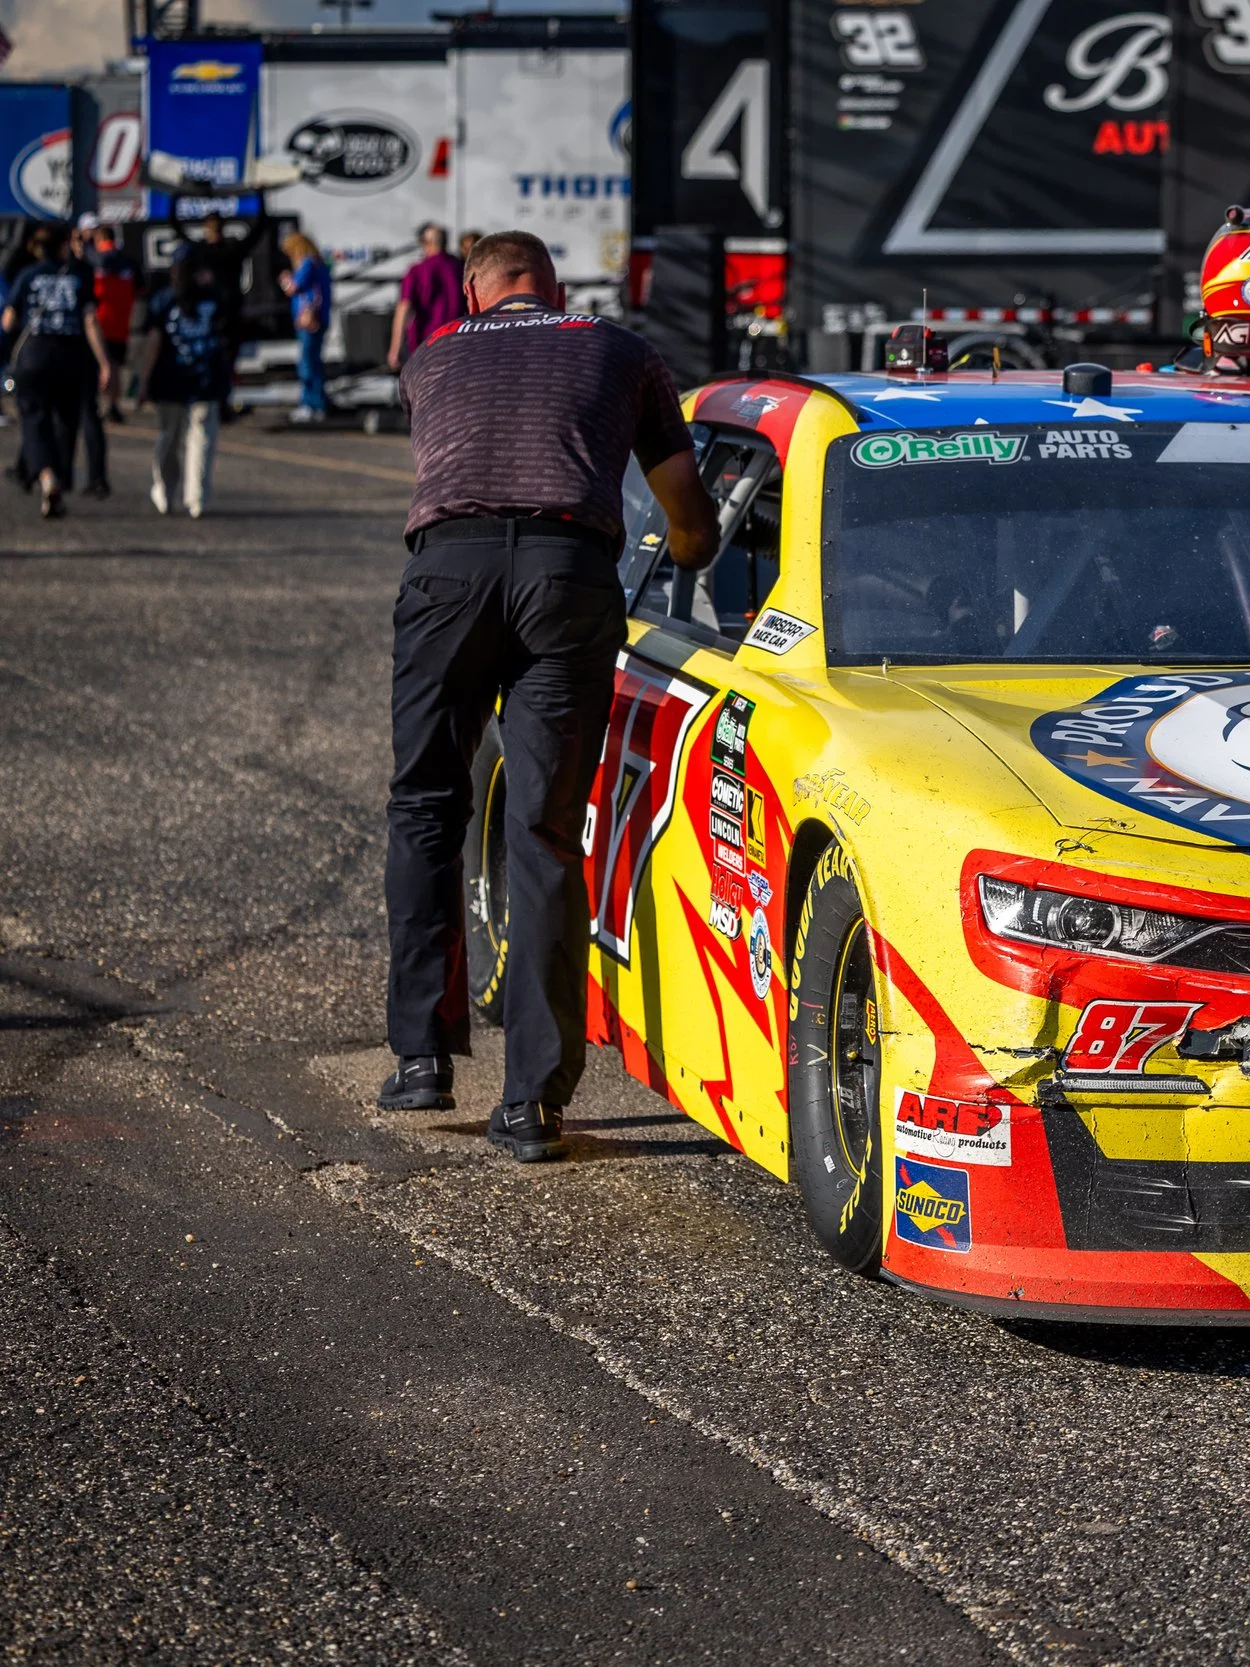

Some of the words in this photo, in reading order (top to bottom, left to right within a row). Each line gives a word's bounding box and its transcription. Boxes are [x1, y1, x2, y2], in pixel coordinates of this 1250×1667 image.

[836, 12, 923, 66] 32
[859, 433, 1020, 465] O'Reilly
[1038, 443, 1133, 460] PARTS
[1046, 430, 1120, 444] AUTO
[752, 629, 772, 642] RACE
[768, 634, 788, 649] CAR
[768, 616, 803, 637] NASCAR
[1051, 674, 1234, 748] PROUD
[712, 777, 744, 813] COMETIC
[711, 815, 740, 847] LINCOLN
[718, 843, 743, 871] WELDERS
[709, 900, 741, 939] MSD
[1065, 1000, 1203, 1074] 87
[897, 1091, 1002, 1137] ARP
[896, 1124, 932, 1141] automotive
[958, 1138, 1007, 1150] products
[899, 1190, 961, 1222] SUNOCO
